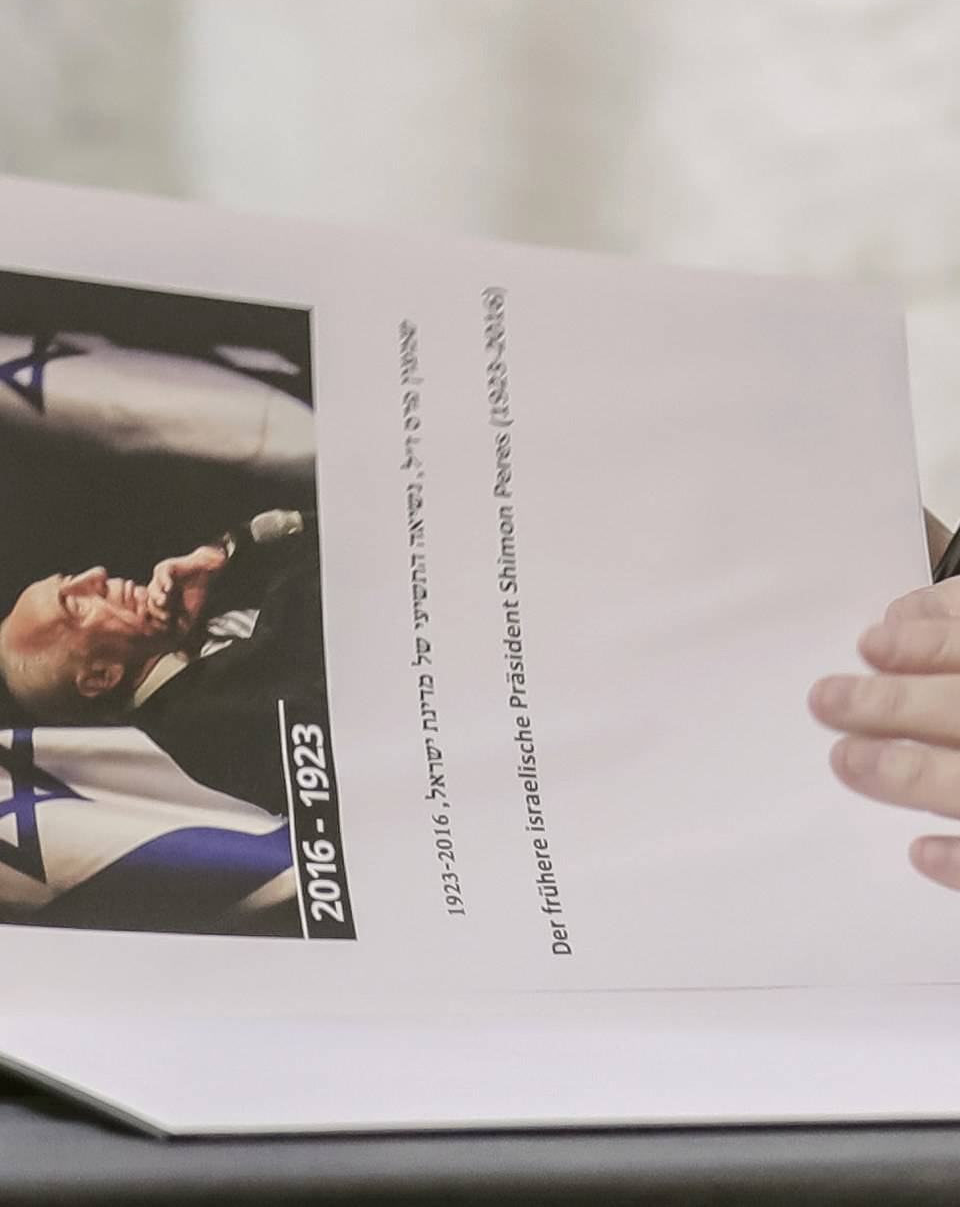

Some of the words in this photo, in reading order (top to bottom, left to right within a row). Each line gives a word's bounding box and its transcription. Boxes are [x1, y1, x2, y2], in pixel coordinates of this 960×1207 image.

[494, 433, 513, 499] Peres
[497, 505, 518, 595] Shimon
[411, 637, 432, 667] של
[502, 598, 529, 710] Präsident
[419, 674, 438, 733] מדינת
[291, 723, 331, 807] 1923
[425, 737, 450, 809] ישראל,
[515, 715, 546, 833] israelische
[302, 839, 345, 923] 2016
[432, 814, 466, 916] 1923-2016
[534, 837, 563, 915] frühere
[550, 919, 573, 956] Der
